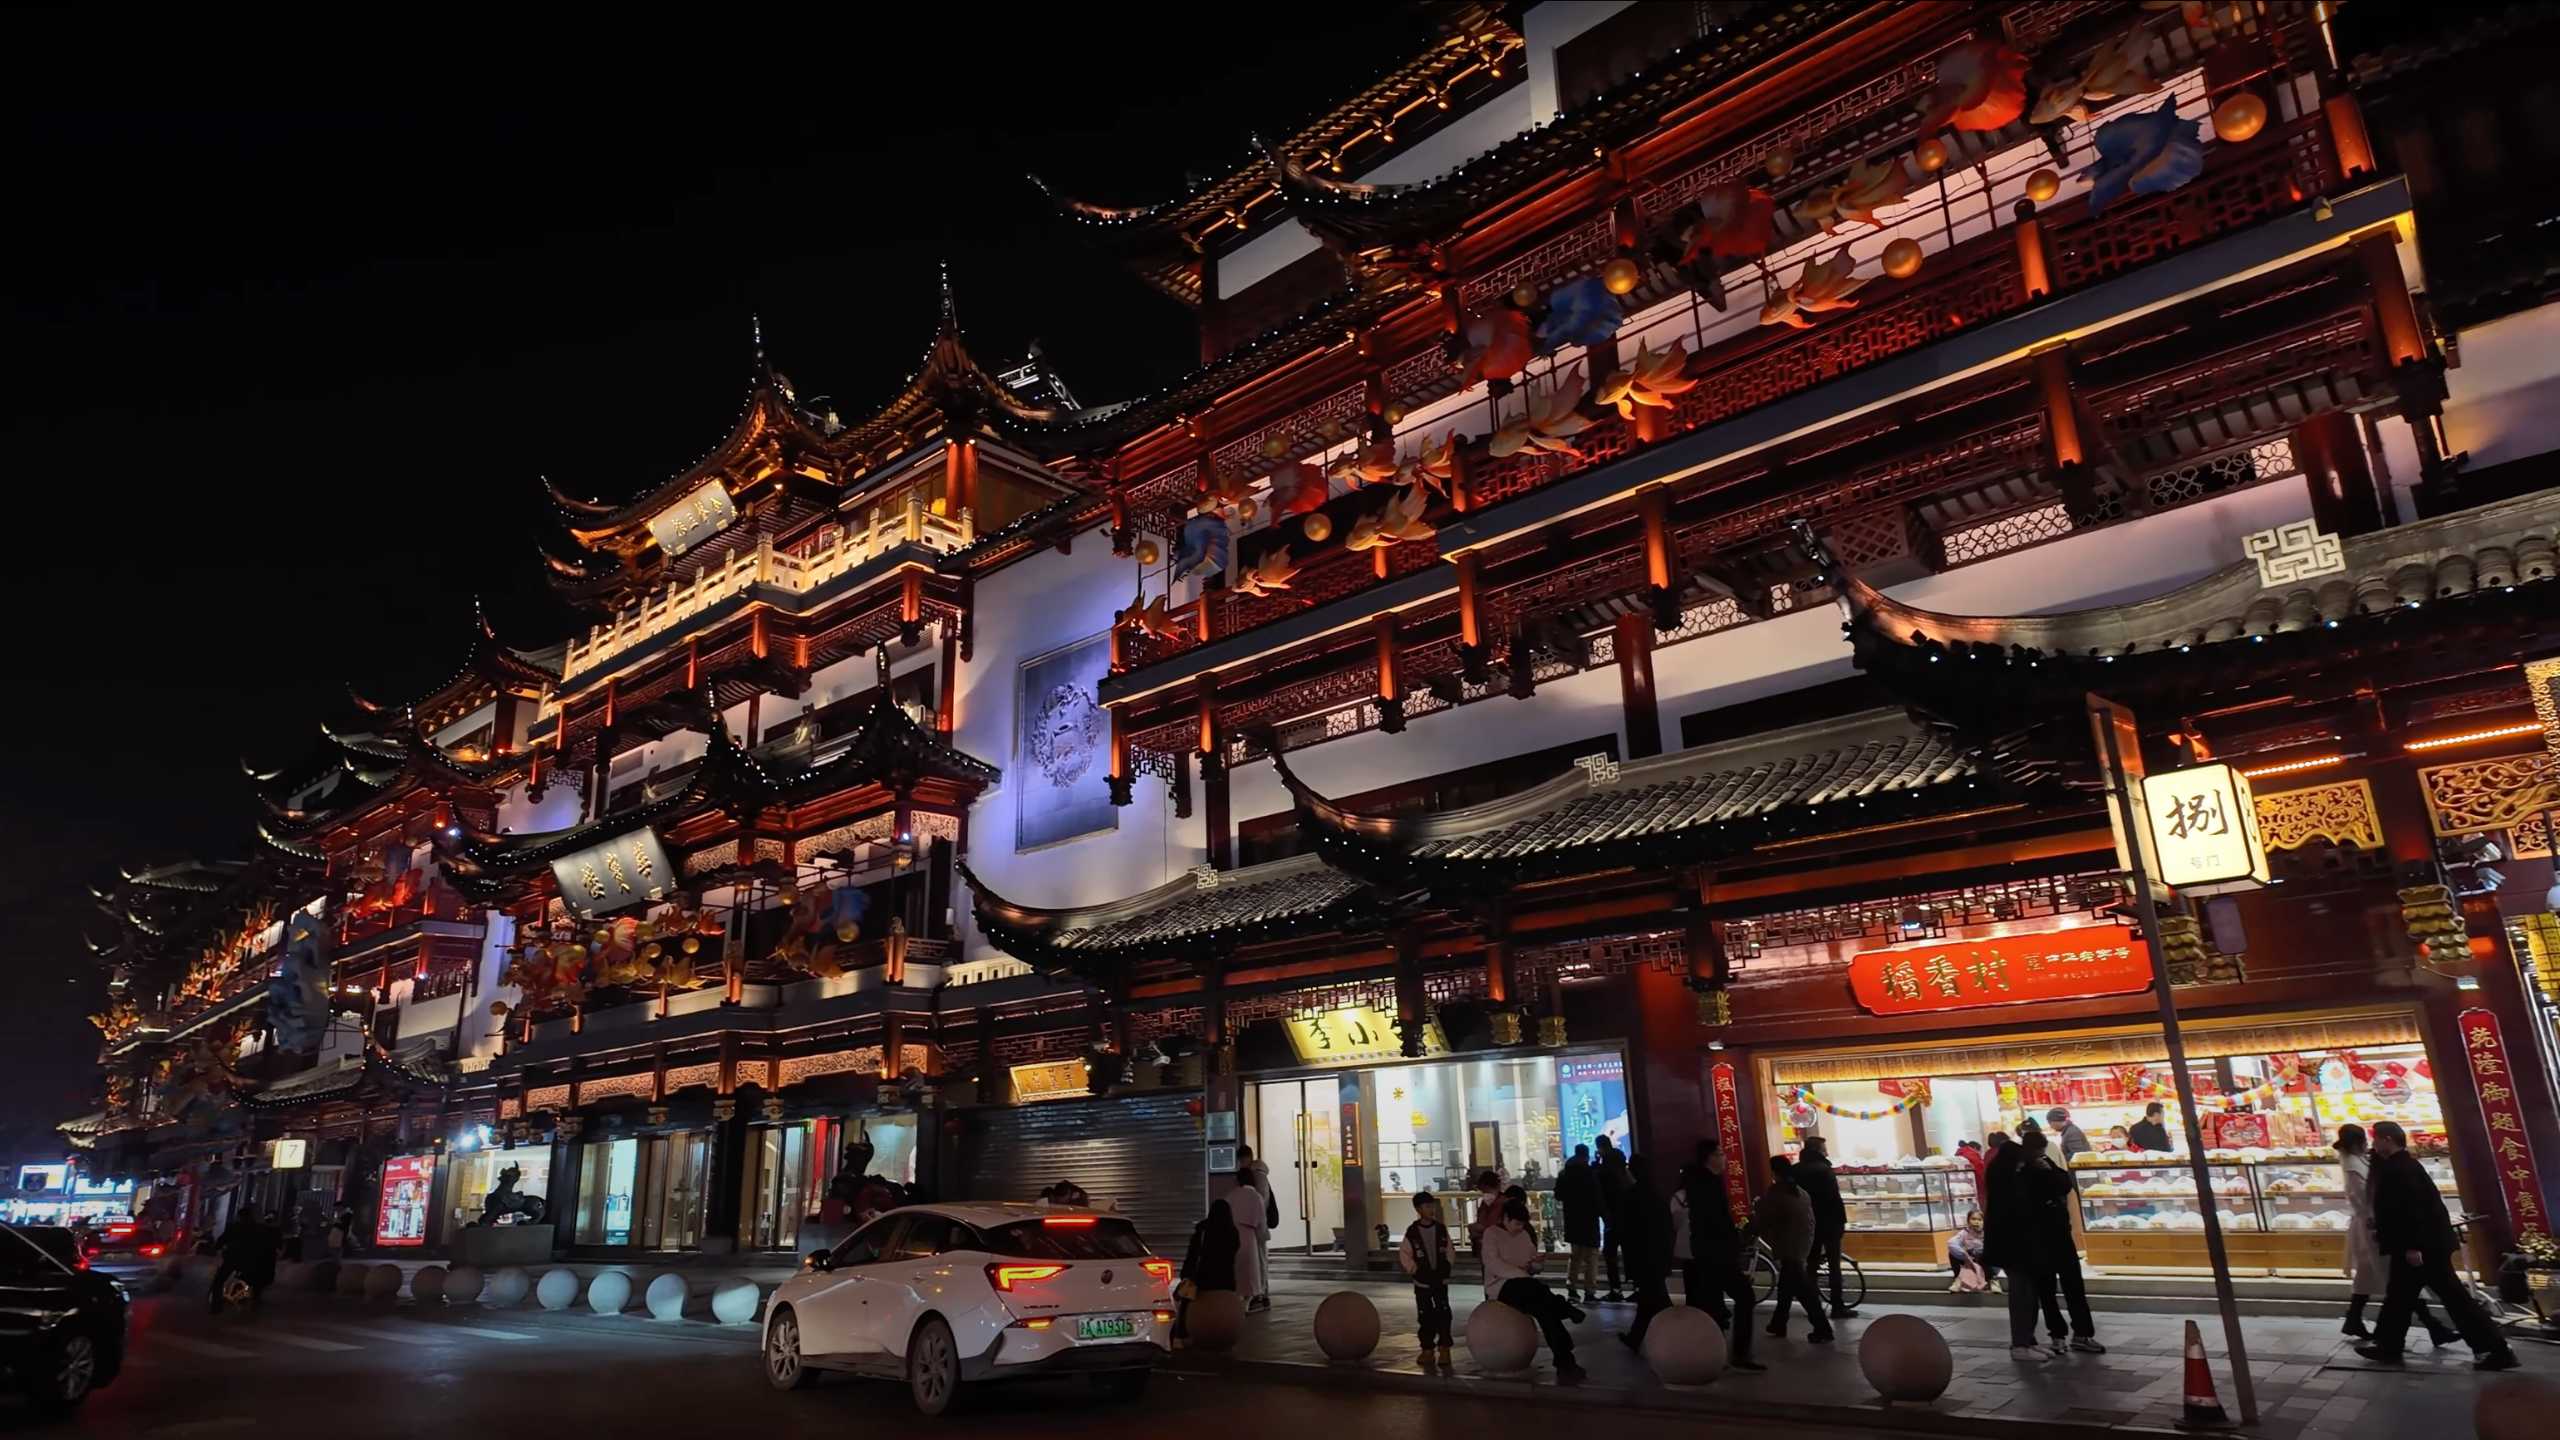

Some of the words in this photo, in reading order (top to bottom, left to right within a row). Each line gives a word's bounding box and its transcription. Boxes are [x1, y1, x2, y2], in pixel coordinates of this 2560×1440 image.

[2165, 789, 2229, 840] 捌
[1880, 949, 2009, 1002] 稻香村
[1310, 1018, 1403, 1050] 李小
